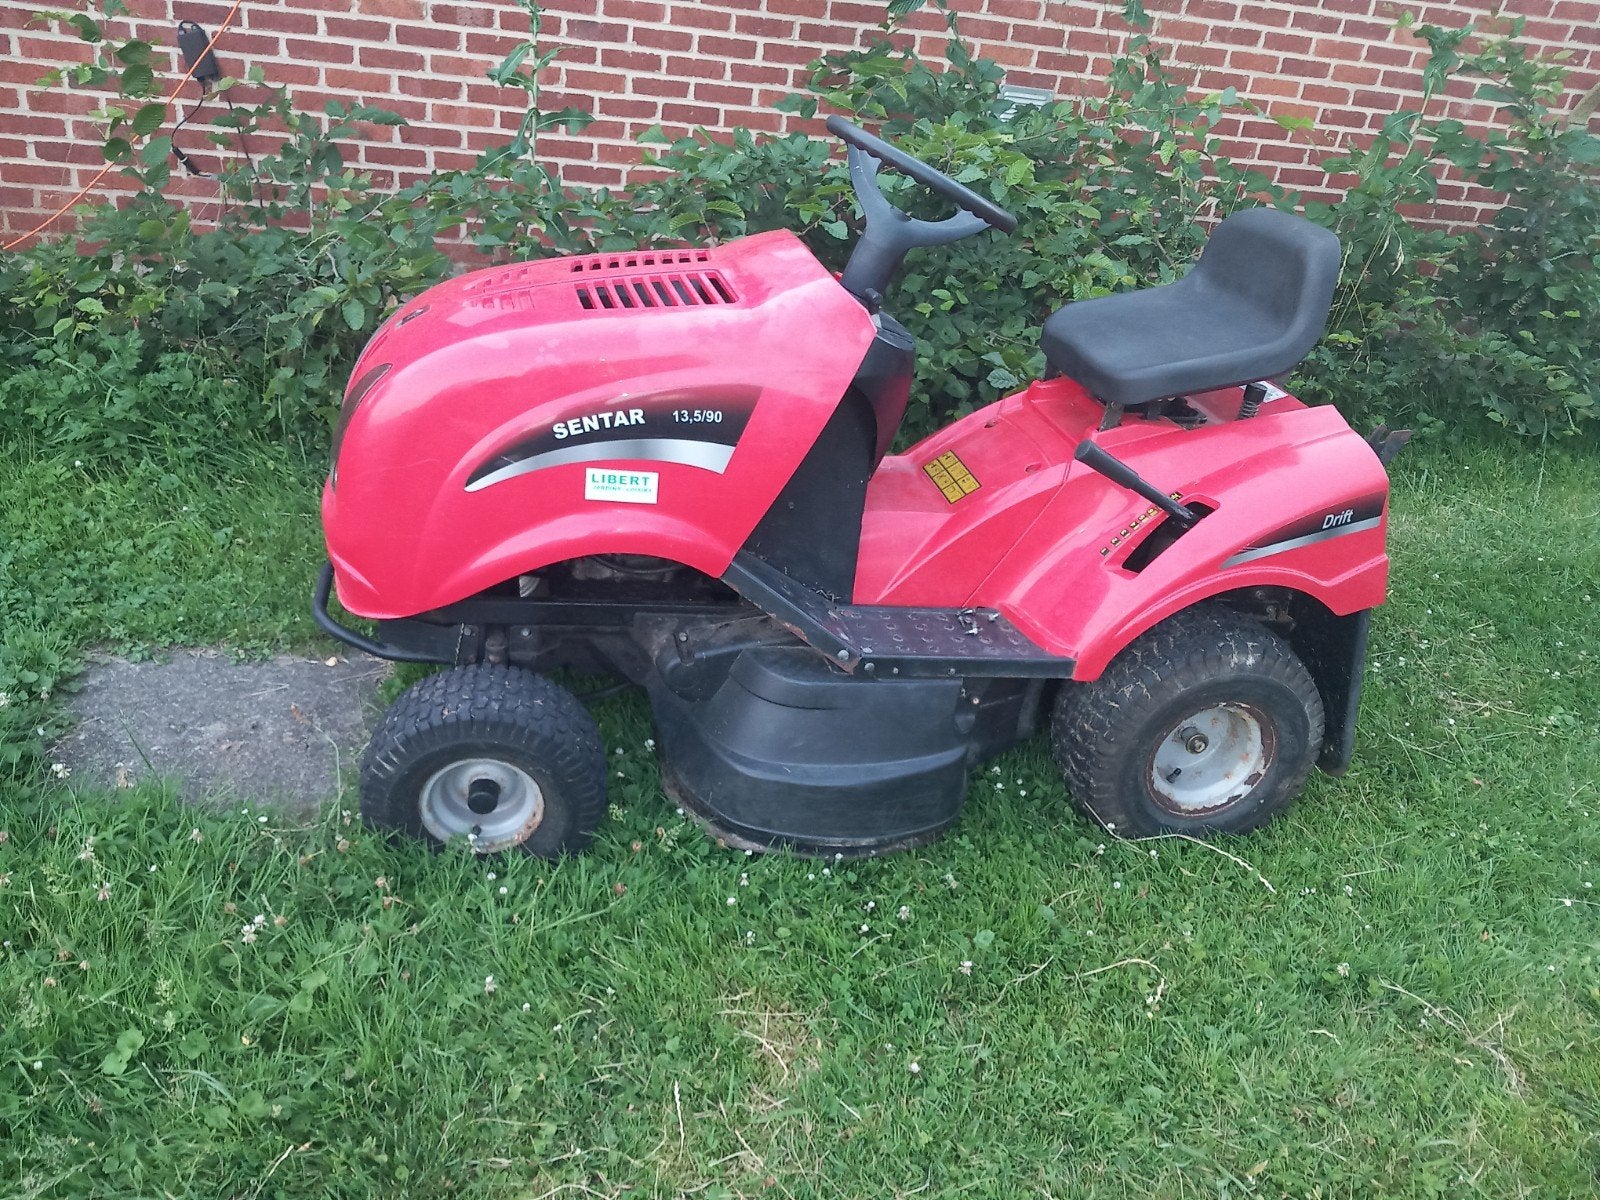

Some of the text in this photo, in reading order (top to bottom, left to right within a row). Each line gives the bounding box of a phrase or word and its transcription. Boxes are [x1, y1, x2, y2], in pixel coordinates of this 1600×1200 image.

[552, 408, 723, 439] SENTAR 13,5/90
[591, 473, 650, 486] LIBERT
[1322, 508, 1354, 529] Drift
